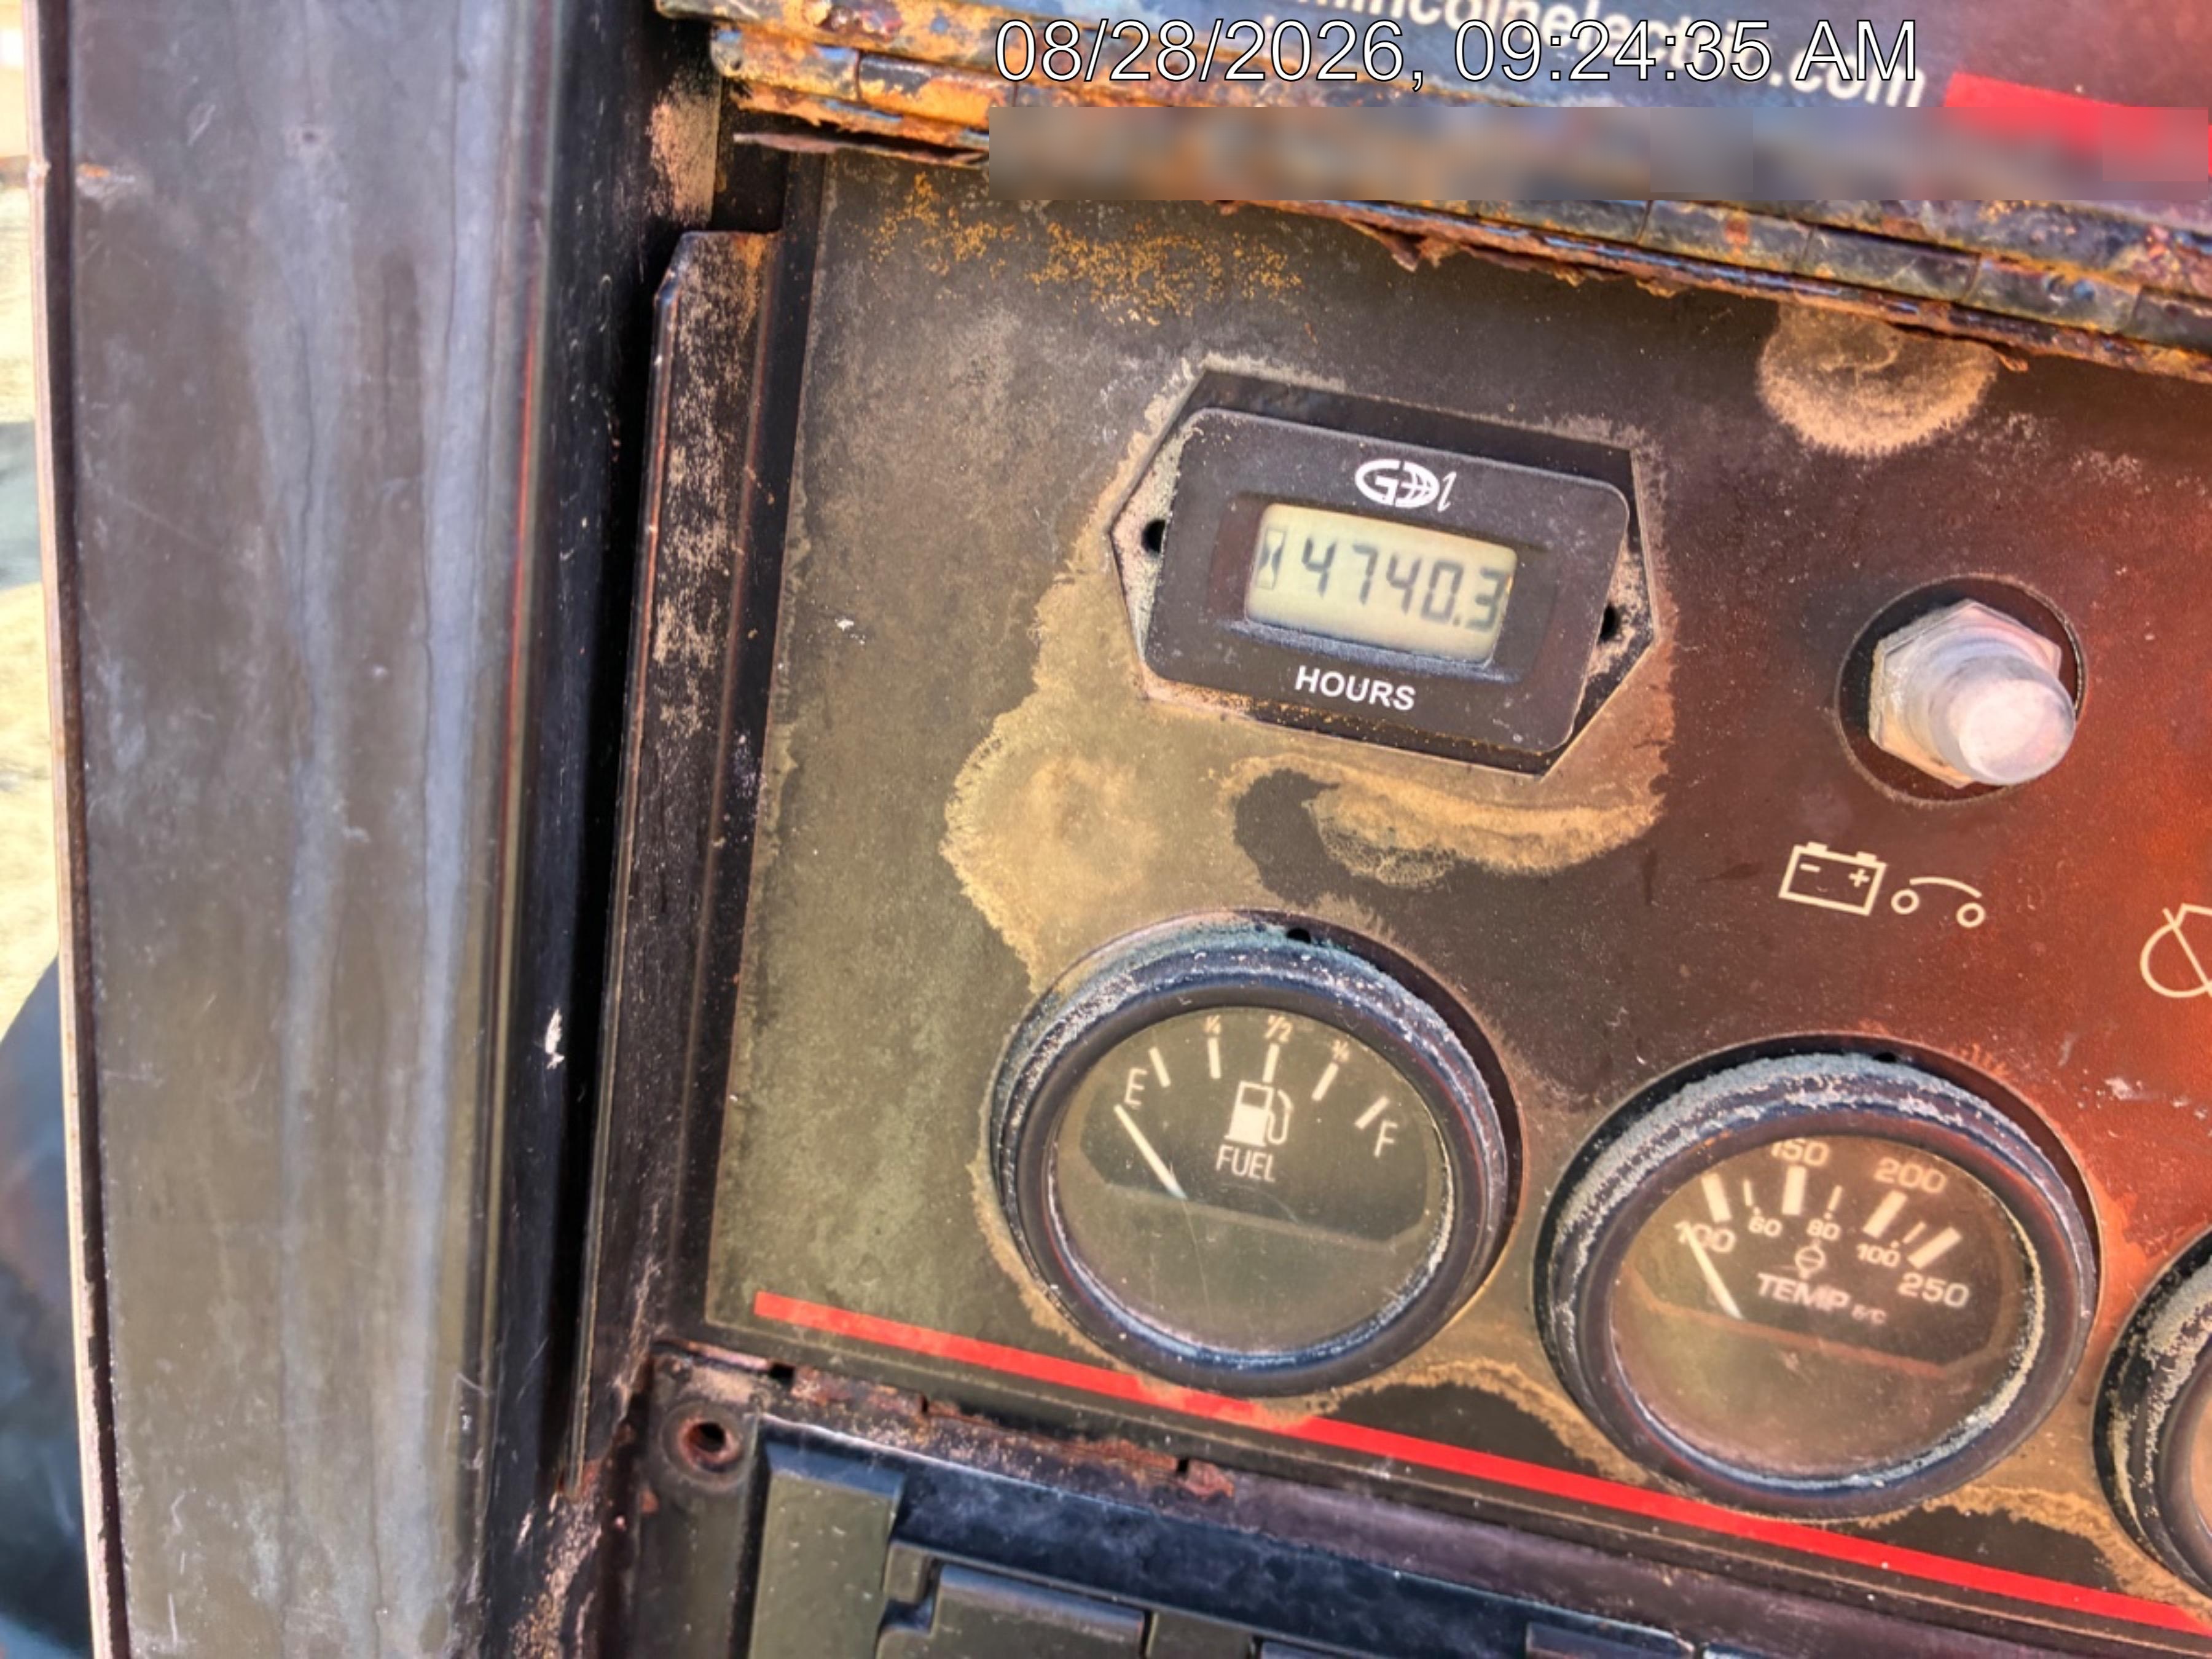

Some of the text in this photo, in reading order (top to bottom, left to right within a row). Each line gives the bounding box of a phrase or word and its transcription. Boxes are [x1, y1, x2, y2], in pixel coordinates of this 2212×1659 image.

[1301, 536, 1508, 632] 4740.3
[1295, 665, 1416, 712] HOURS
[1124, 1067, 1147, 1106] E
[1374, 1120, 1398, 1157] F
[1216, 1143, 1276, 1183] FUEL
[1874, 1157, 1947, 1194] 200
[1674, 1220, 1736, 1253] 100
[1748, 1215, 1783, 1238] 60
[1806, 1218, 1841, 1242] 80
[1857, 1243, 1901, 1268] 100
[1757, 1272, 1851, 1311] TEMP
[1897, 1272, 1969, 1308] 250
